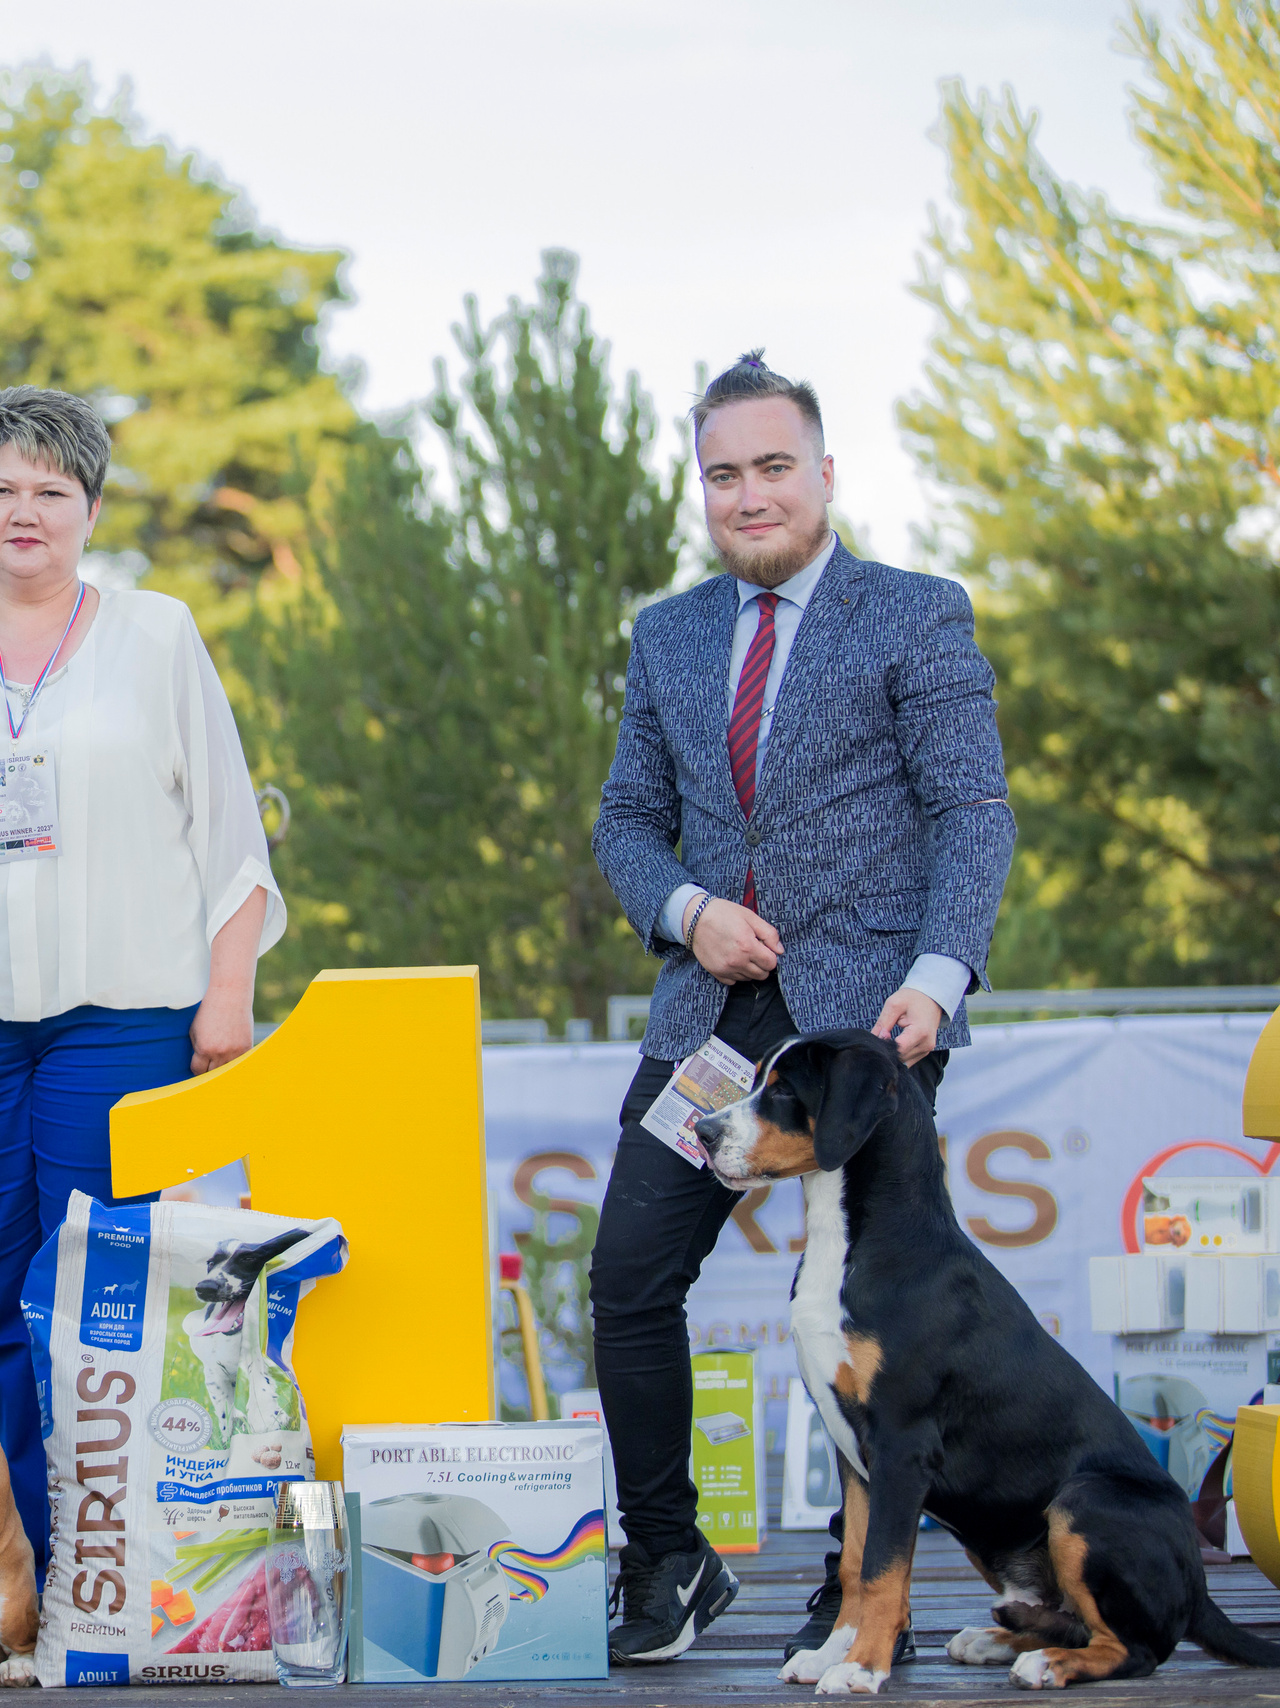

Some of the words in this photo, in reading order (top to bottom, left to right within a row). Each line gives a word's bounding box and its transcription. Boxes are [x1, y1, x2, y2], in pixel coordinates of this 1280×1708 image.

[8, 755, 30, 763] SIRIUS
[10, 828, 33, 836] WINNER
[717, 1061, 737, 1078] SIRIUS
[722, 1053, 742, 1071] WINNER
[108, 965, 496, 1427] 1
[98, 1231, 145, 1244] PREMIUM
[110, 1241, 132, 1249] FOOD
[90, 1302, 136, 1320] ADULT
[267, 1301, 293, 1316] MIUM
[166, 1399, 206, 1415] СОДЕРЖАНИЕ
[161, 1416, 201, 1432] 44%
[371, 1448, 414, 1463] PORT
[418, 1447, 461, 1463] ABLE
[465, 1445, 574, 1463] ELECTRONIC
[165, 1467, 176, 1477] И
[179, 1469, 214, 1483] УТКА
[426, 1471, 454, 1483] 7.5L
[457, 1472, 572, 1483] Cooling&warming
[72, 1367, 136, 1615] SIRIUS
[179, 1487, 216, 1500] Комплекс
[216, 1482, 263, 1496] пробиотиков
[514, 1483, 571, 1492] refrigerators
[187, 1507, 212, 1515] Здоровая
[70, 1622, 126, 1637] PREMIUM
[77, 1671, 118, 1684] ADULT
[141, 1665, 226, 1678] SIRIUS
